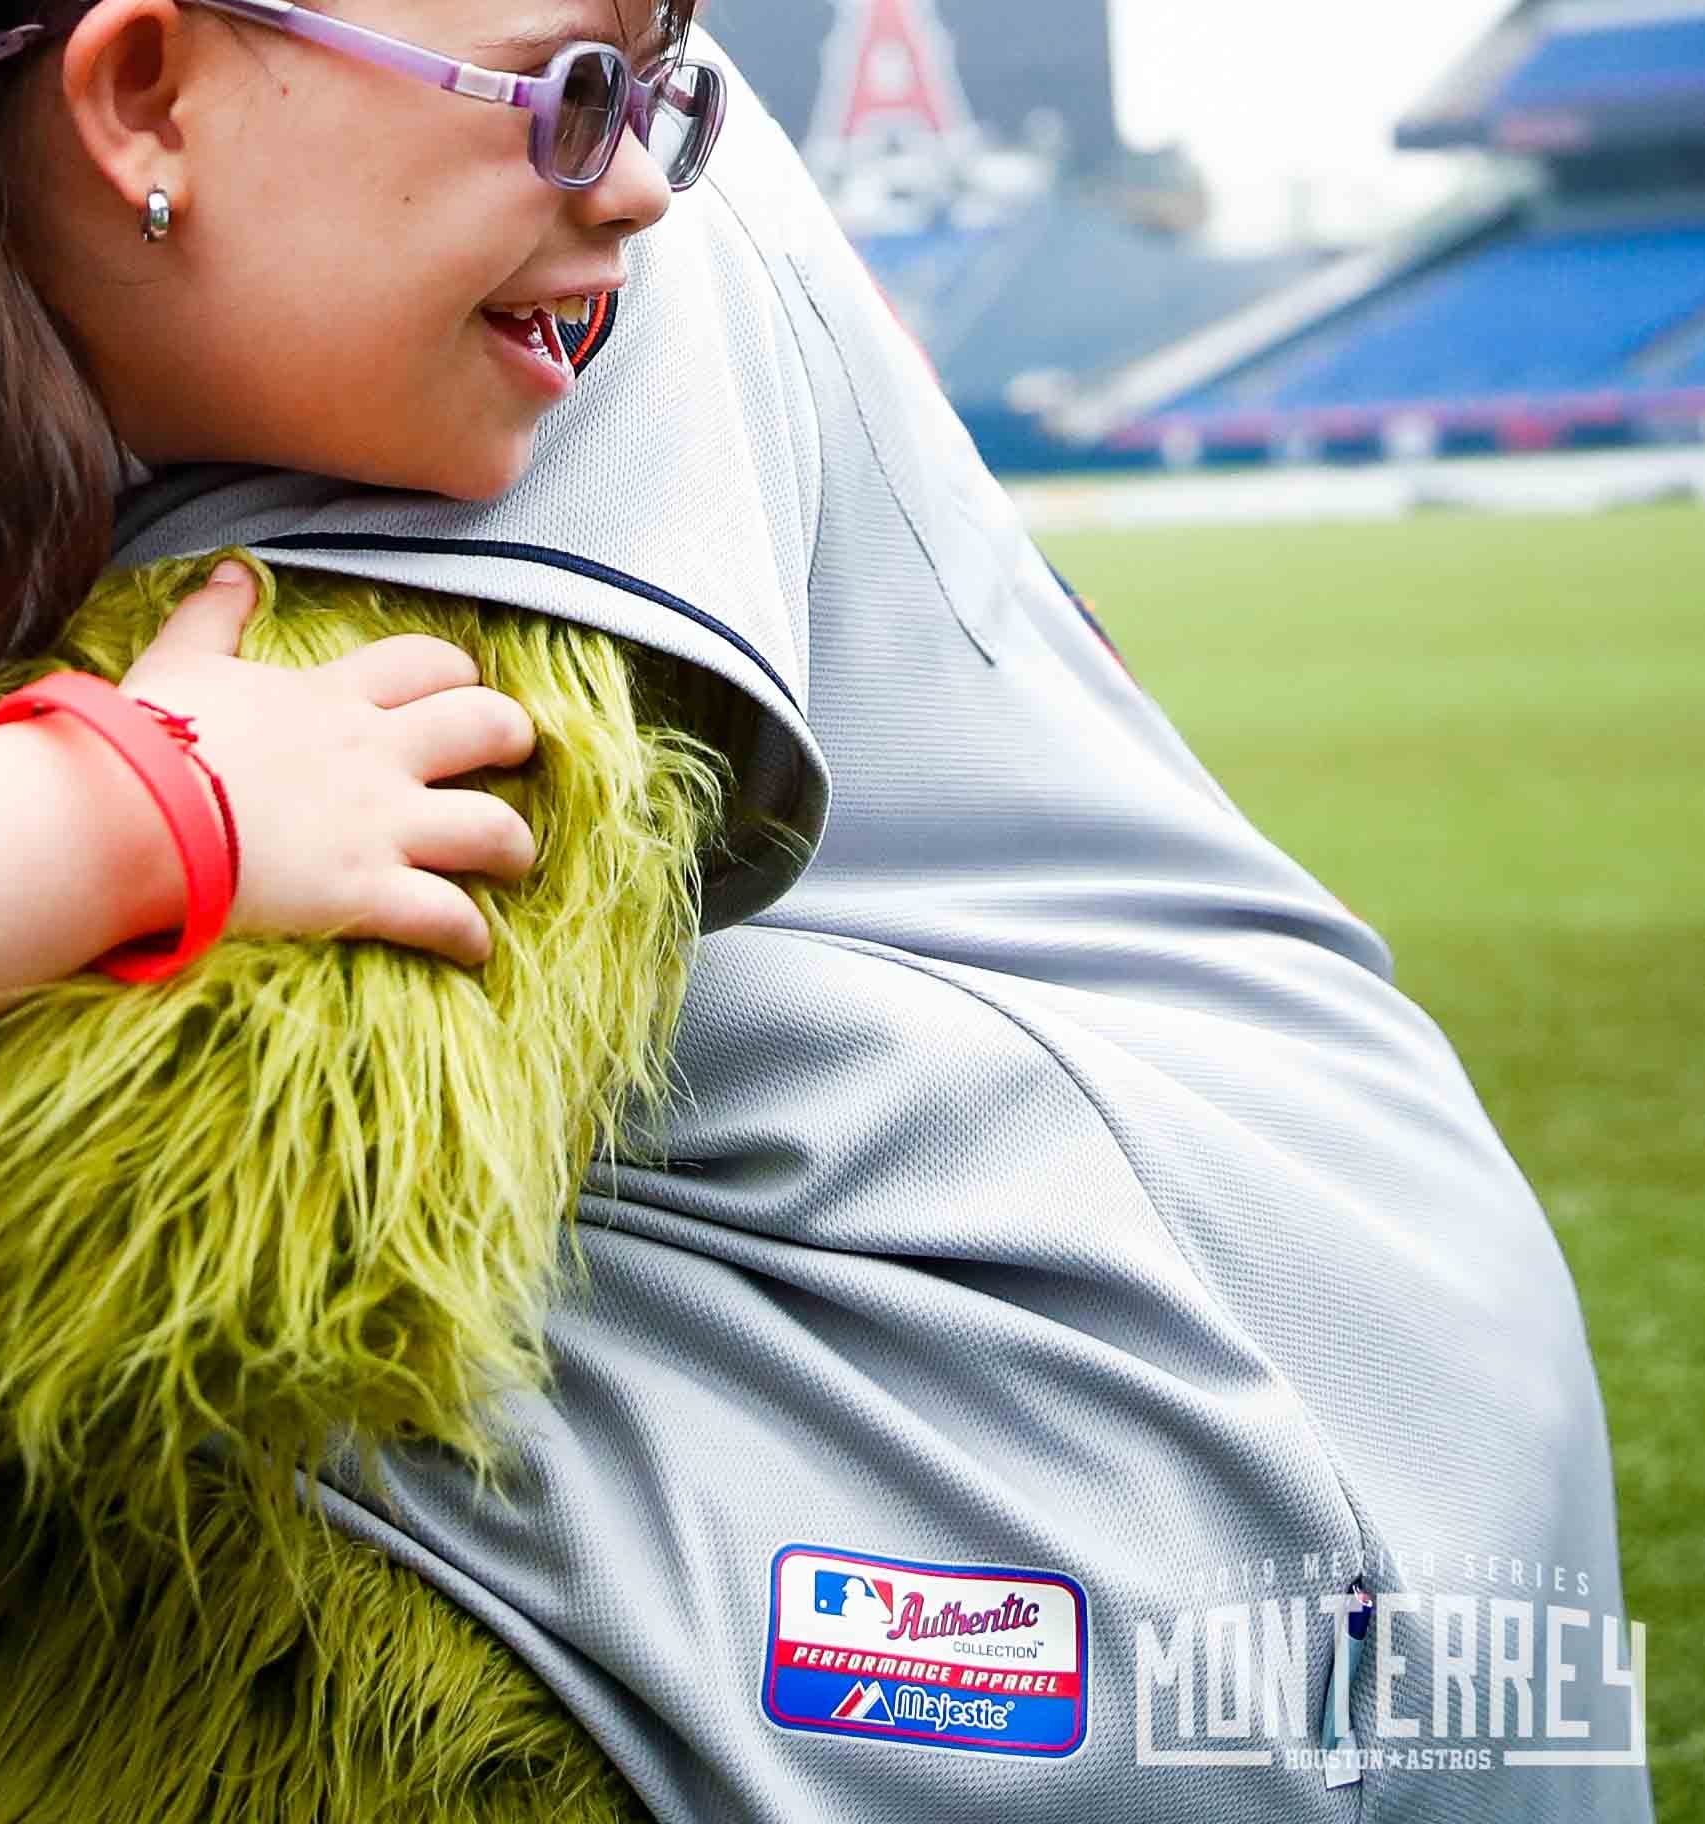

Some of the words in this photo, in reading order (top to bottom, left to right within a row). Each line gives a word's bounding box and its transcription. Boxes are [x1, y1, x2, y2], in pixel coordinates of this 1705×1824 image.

[887, 1591, 1040, 1641] Authentic
[793, 1646, 952, 1683] PERFORMANCE
[960, 1669, 1058, 1693] APPAREL
